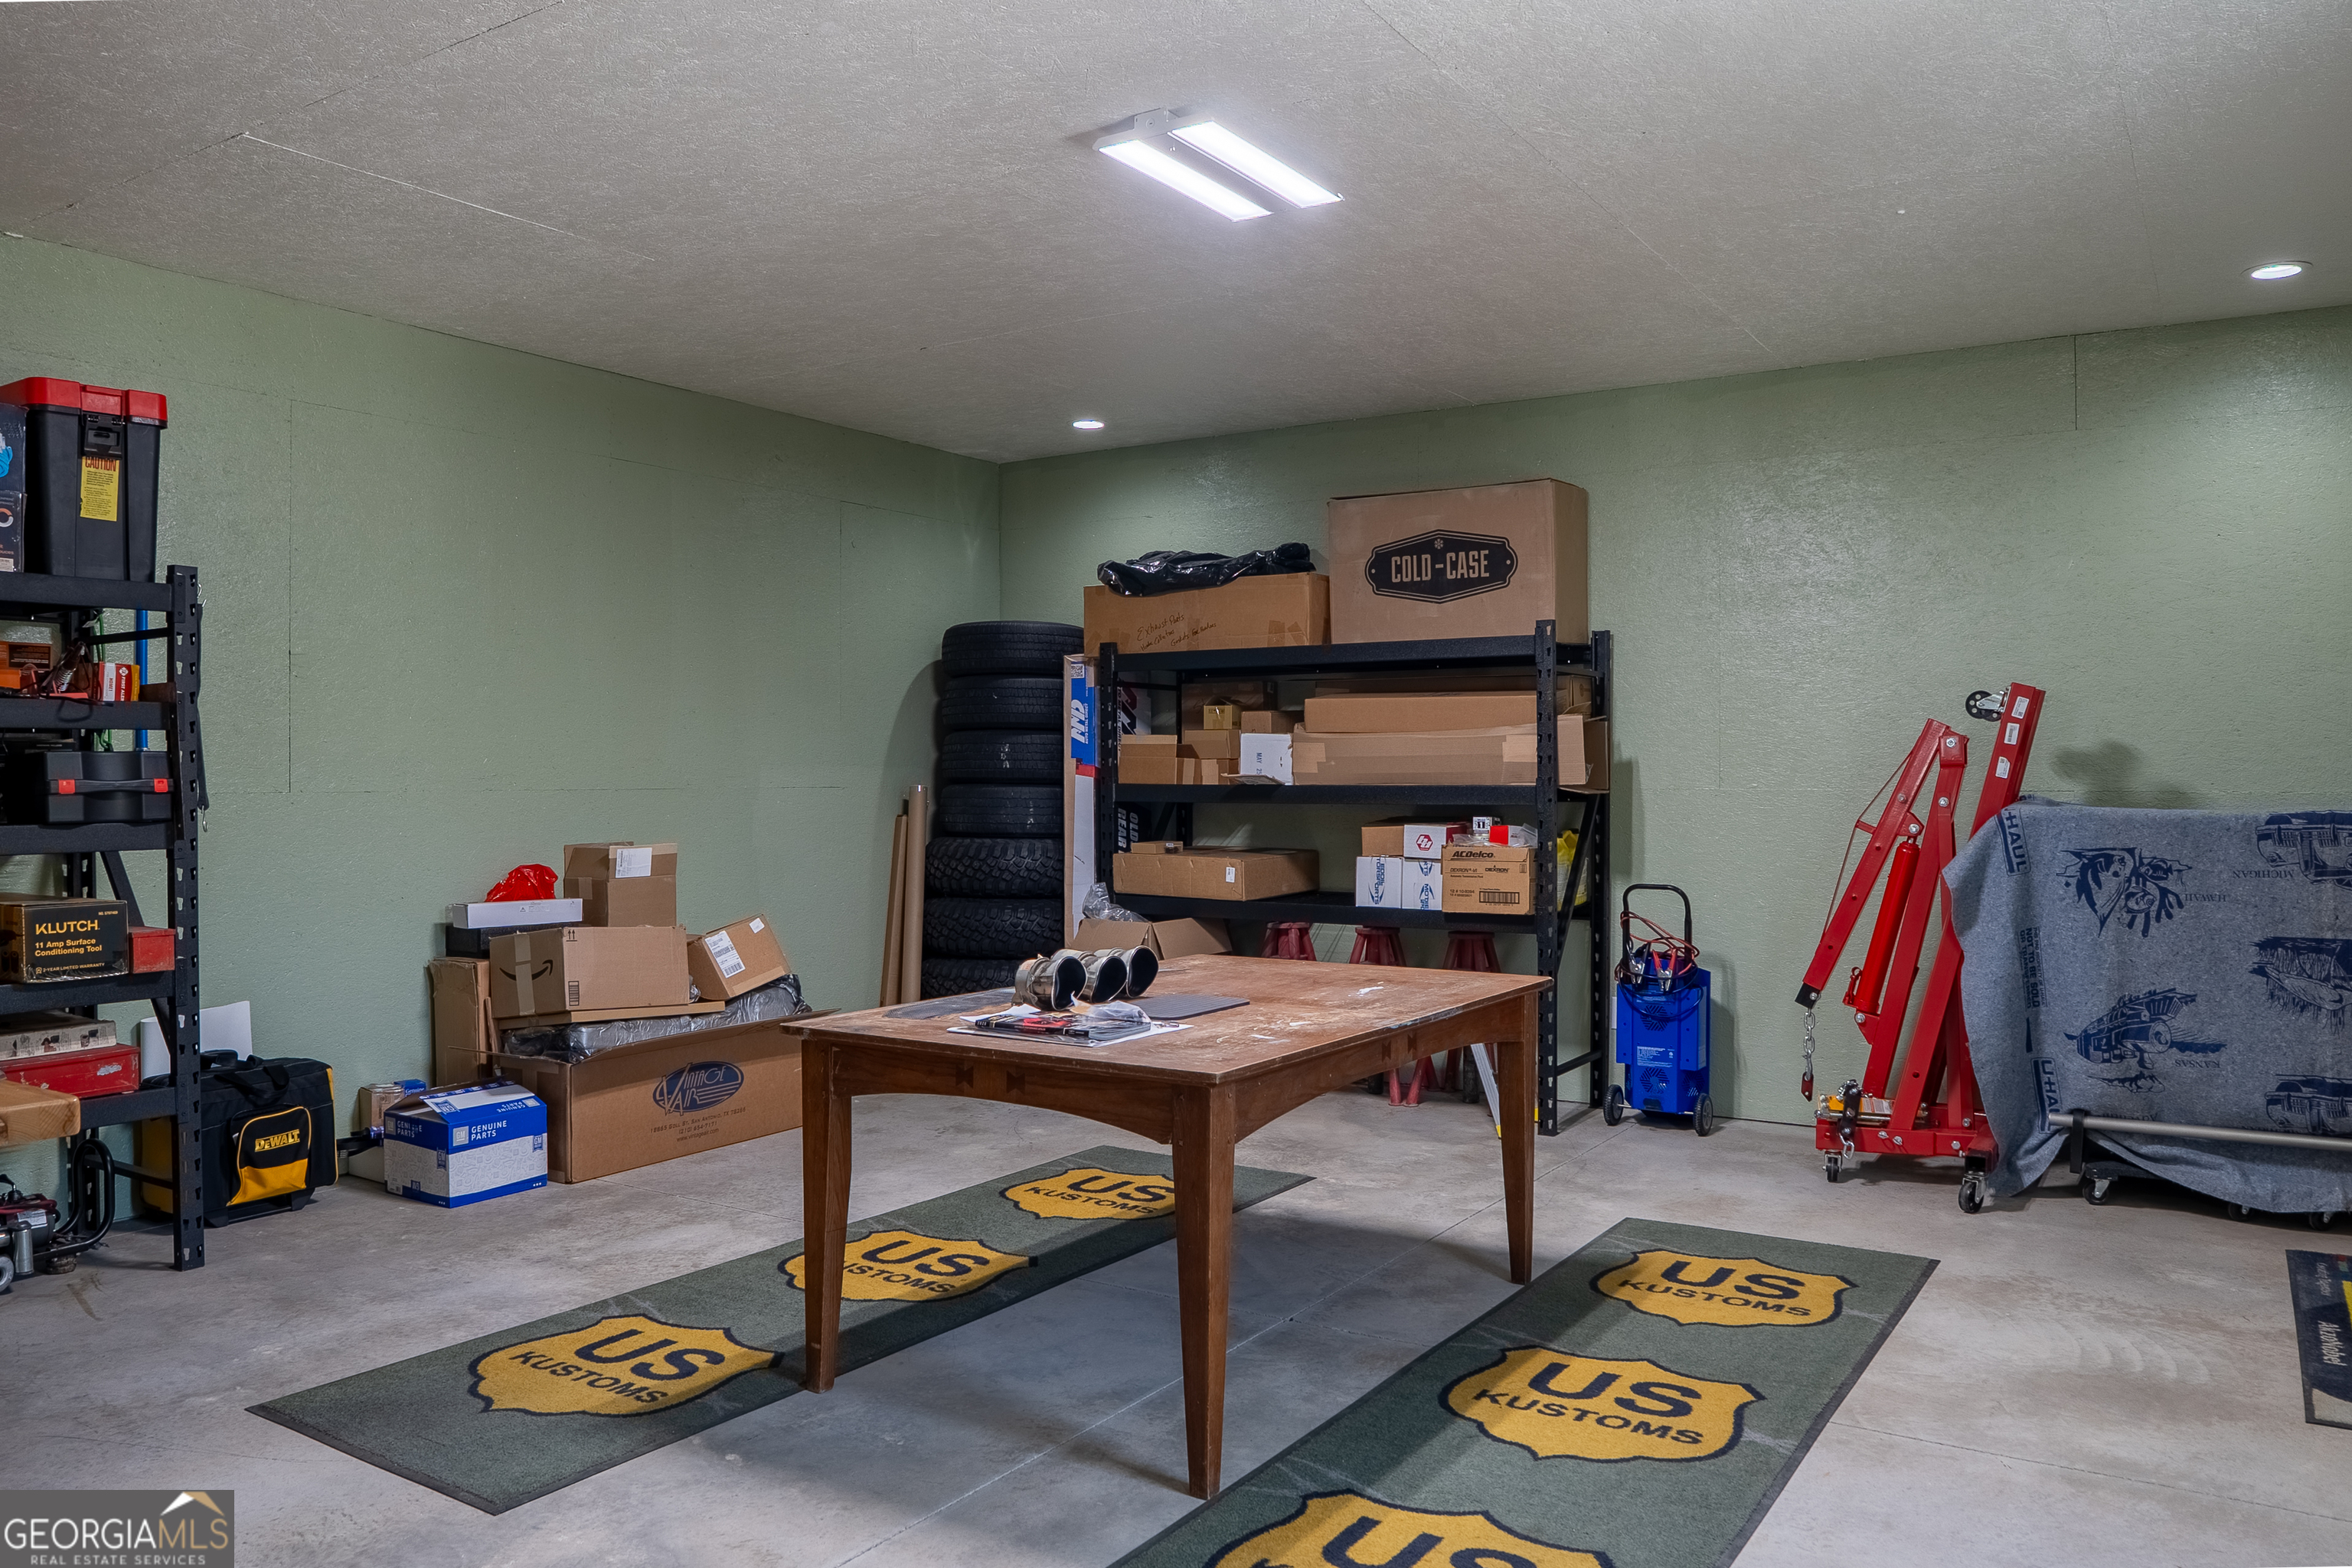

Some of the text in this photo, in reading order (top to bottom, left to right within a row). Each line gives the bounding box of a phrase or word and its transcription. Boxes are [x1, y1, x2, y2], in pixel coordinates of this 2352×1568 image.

[85, 457, 116, 472] CAUTION
[1391, 550, 1490, 583] COLD-CASE
[1118, 808, 1127, 848] REAR
[2233, 870, 2295, 879] MICHIGAN
[2184, 893, 2226, 902] HAWAII
[35, 920, 99, 935] KLUTCH
[2020, 929, 2026, 943] OR
[34, 947, 85, 957] Conditioning
[2025, 927, 2040, 1008] NOT TO BE SOLD
[2175, 1060, 2221, 1069] KANSAS
[255, 1129, 301, 1152] DEWALT
[397, 1128, 415, 1138] PARTS
[456, 1129, 466, 1139] GM
[471, 1120, 508, 1134] GENUINE
[471, 1129, 497, 1141] PARTS
[1024, 1187, 1158, 1214] KUSTOMS
[1069, 1175, 1175, 1202] US
[861, 1240, 990, 1276] US
[842, 1263, 956, 1293] STOMS
[1661, 1260, 1805, 1300] US
[1617, 1279, 1811, 1316] KUSTOMS
[574, 1328, 726, 1380] US
[2318, 1321, 2348, 1367] AkzoNobel
[508, 1351, 669, 1403] KUSTOMS
[1527, 1362, 1703, 1418] US
[1472, 1389, 1704, 1446] KUSTOMS
